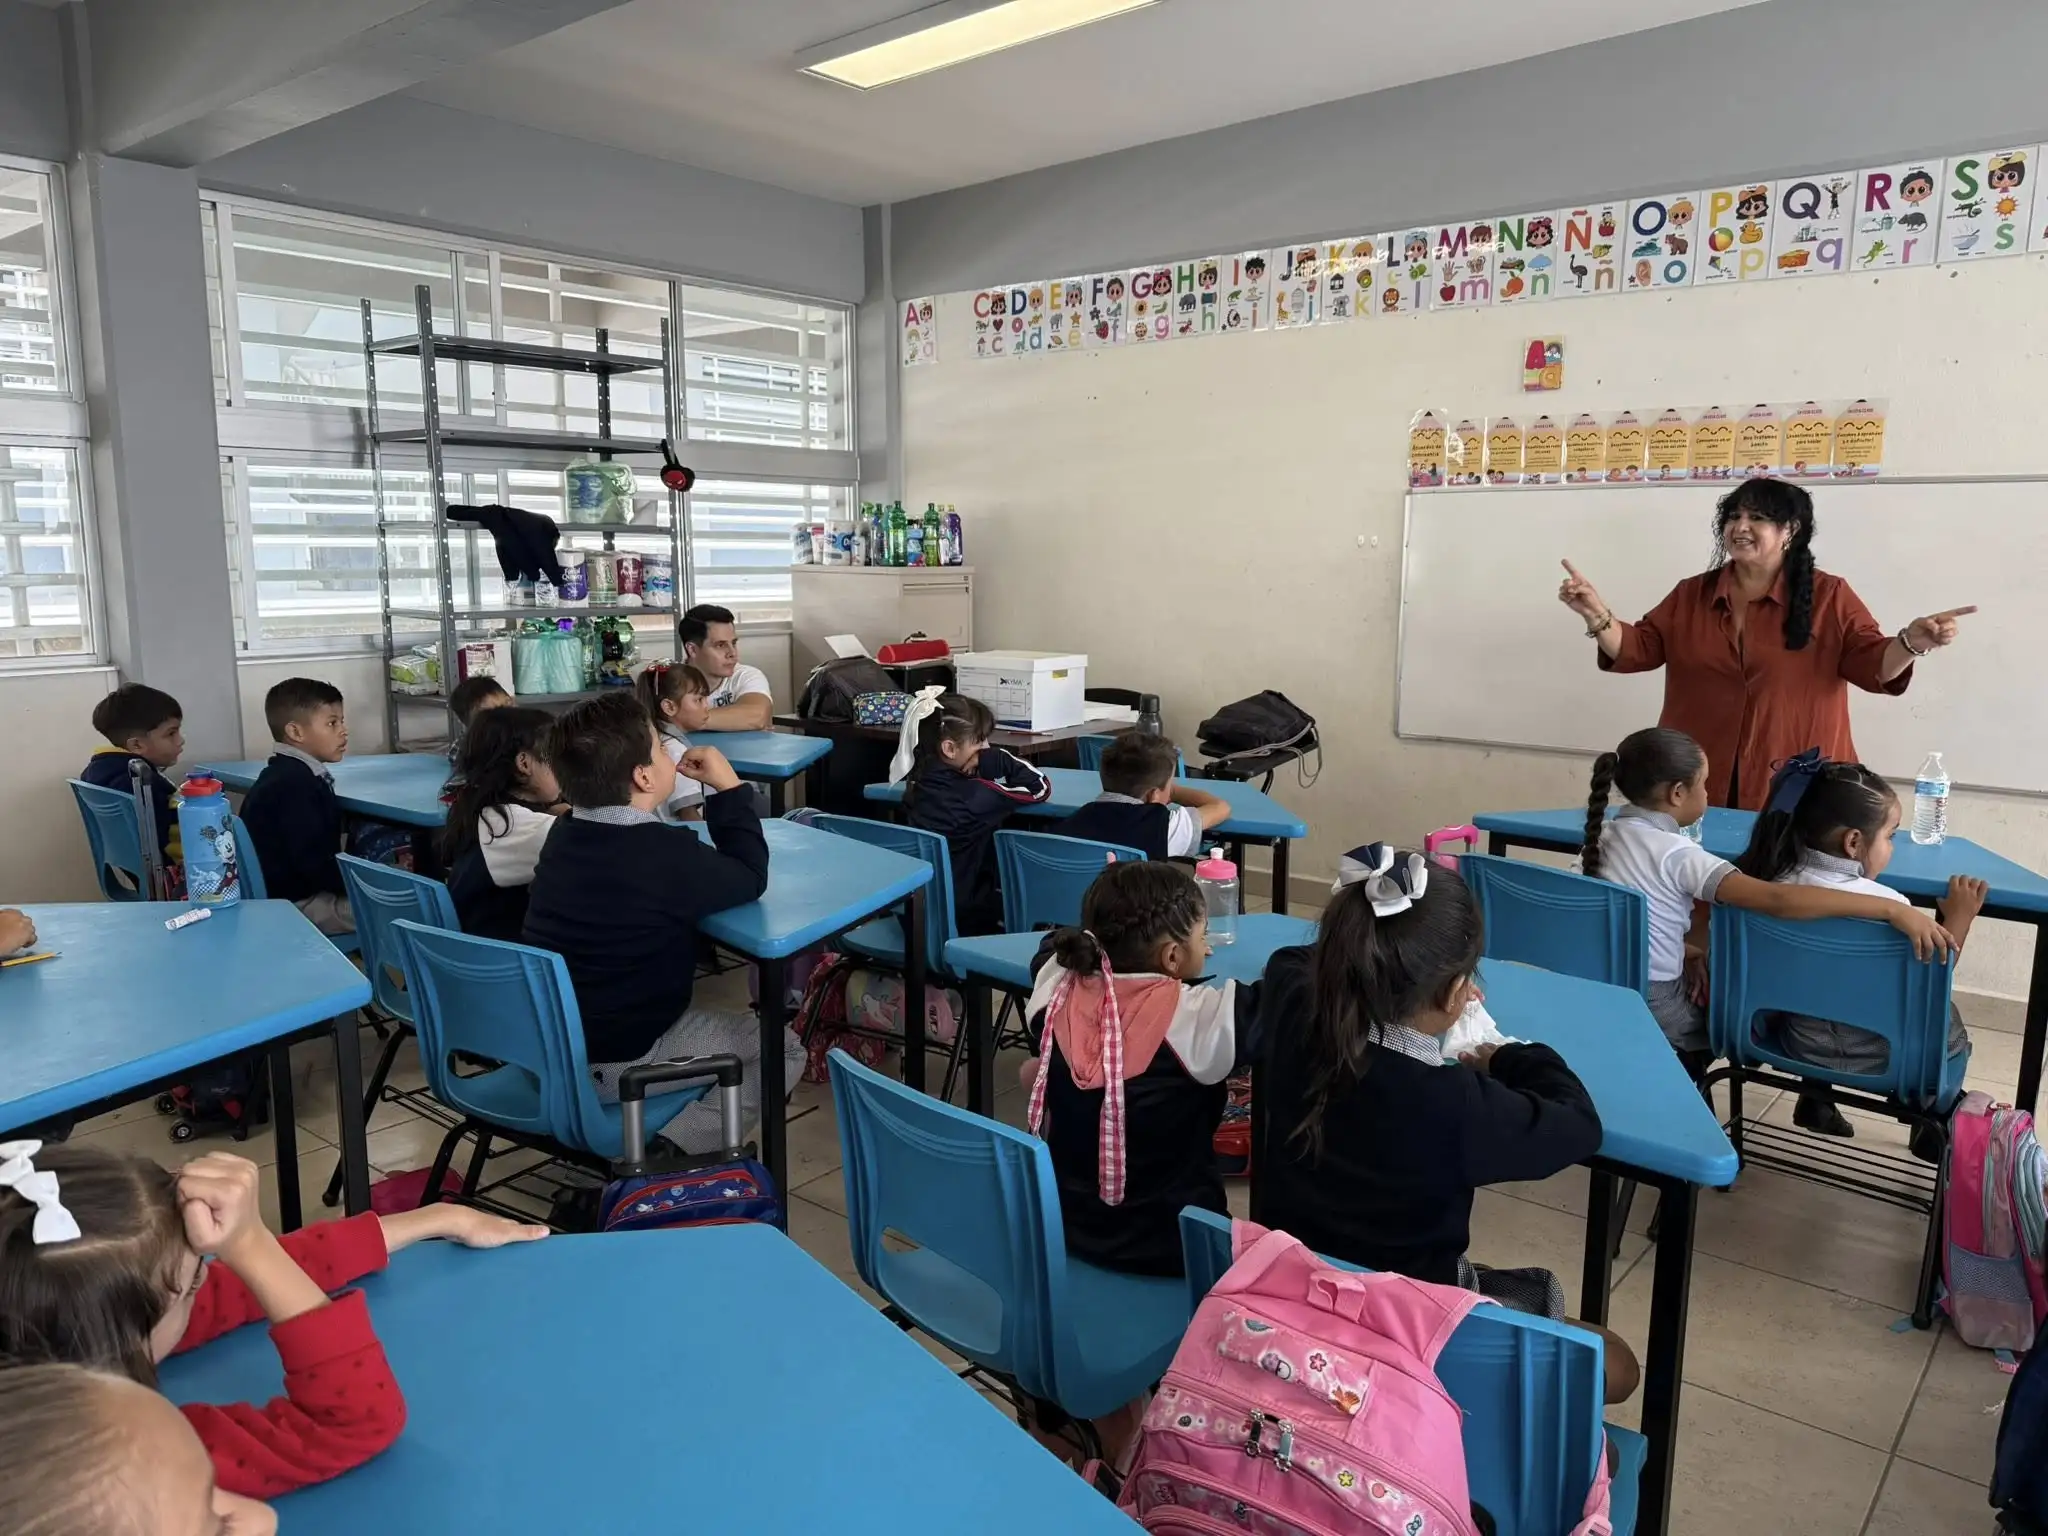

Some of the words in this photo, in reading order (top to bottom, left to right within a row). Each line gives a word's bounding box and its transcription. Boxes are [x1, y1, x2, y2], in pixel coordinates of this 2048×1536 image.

[1865, 173, 1892, 212] R
[1951, 159, 1980, 200] S
[1710, 192, 1732, 228] P
[1783, 182, 1821, 219] Q
[1564, 209, 1592, 252] Ñ
[1633, 201, 1667, 236] O
[1436, 226, 1468, 259] M
[1498, 218, 1524, 253] N
[1994, 223, 2015, 250] s
[1387, 236, 1400, 267] L
[1739, 248, 1765, 280] p
[1816, 238, 1843, 270] q
[1902, 238, 1919, 264] r
[1177, 264, 1194, 293] H
[1233, 258, 1239, 286] I
[1279, 250, 1293, 281] J
[1594, 259, 1614, 290] ñ
[1664, 260, 1687, 283] o
[1050, 283, 1062, 310] E
[1092, 277, 1103, 305] F
[1131, 272, 1152, 299] G
[1460, 279, 1489, 301] m
[1531, 273, 1550, 295] n
[905, 302, 920, 328] A
[973, 293, 990, 318] C
[1011, 290, 1027, 315] D
[1252, 302, 1258, 328] i
[1354, 289, 1371, 316] k
[1112, 319, 1119, 342] f
[1155, 315, 1169, 339] g
[1202, 306, 1215, 330] h
[922, 341, 934, 357] a
[992, 337, 1003, 353] c
[1029, 327, 1042, 350] d
[1068, 329, 1081, 347] e
